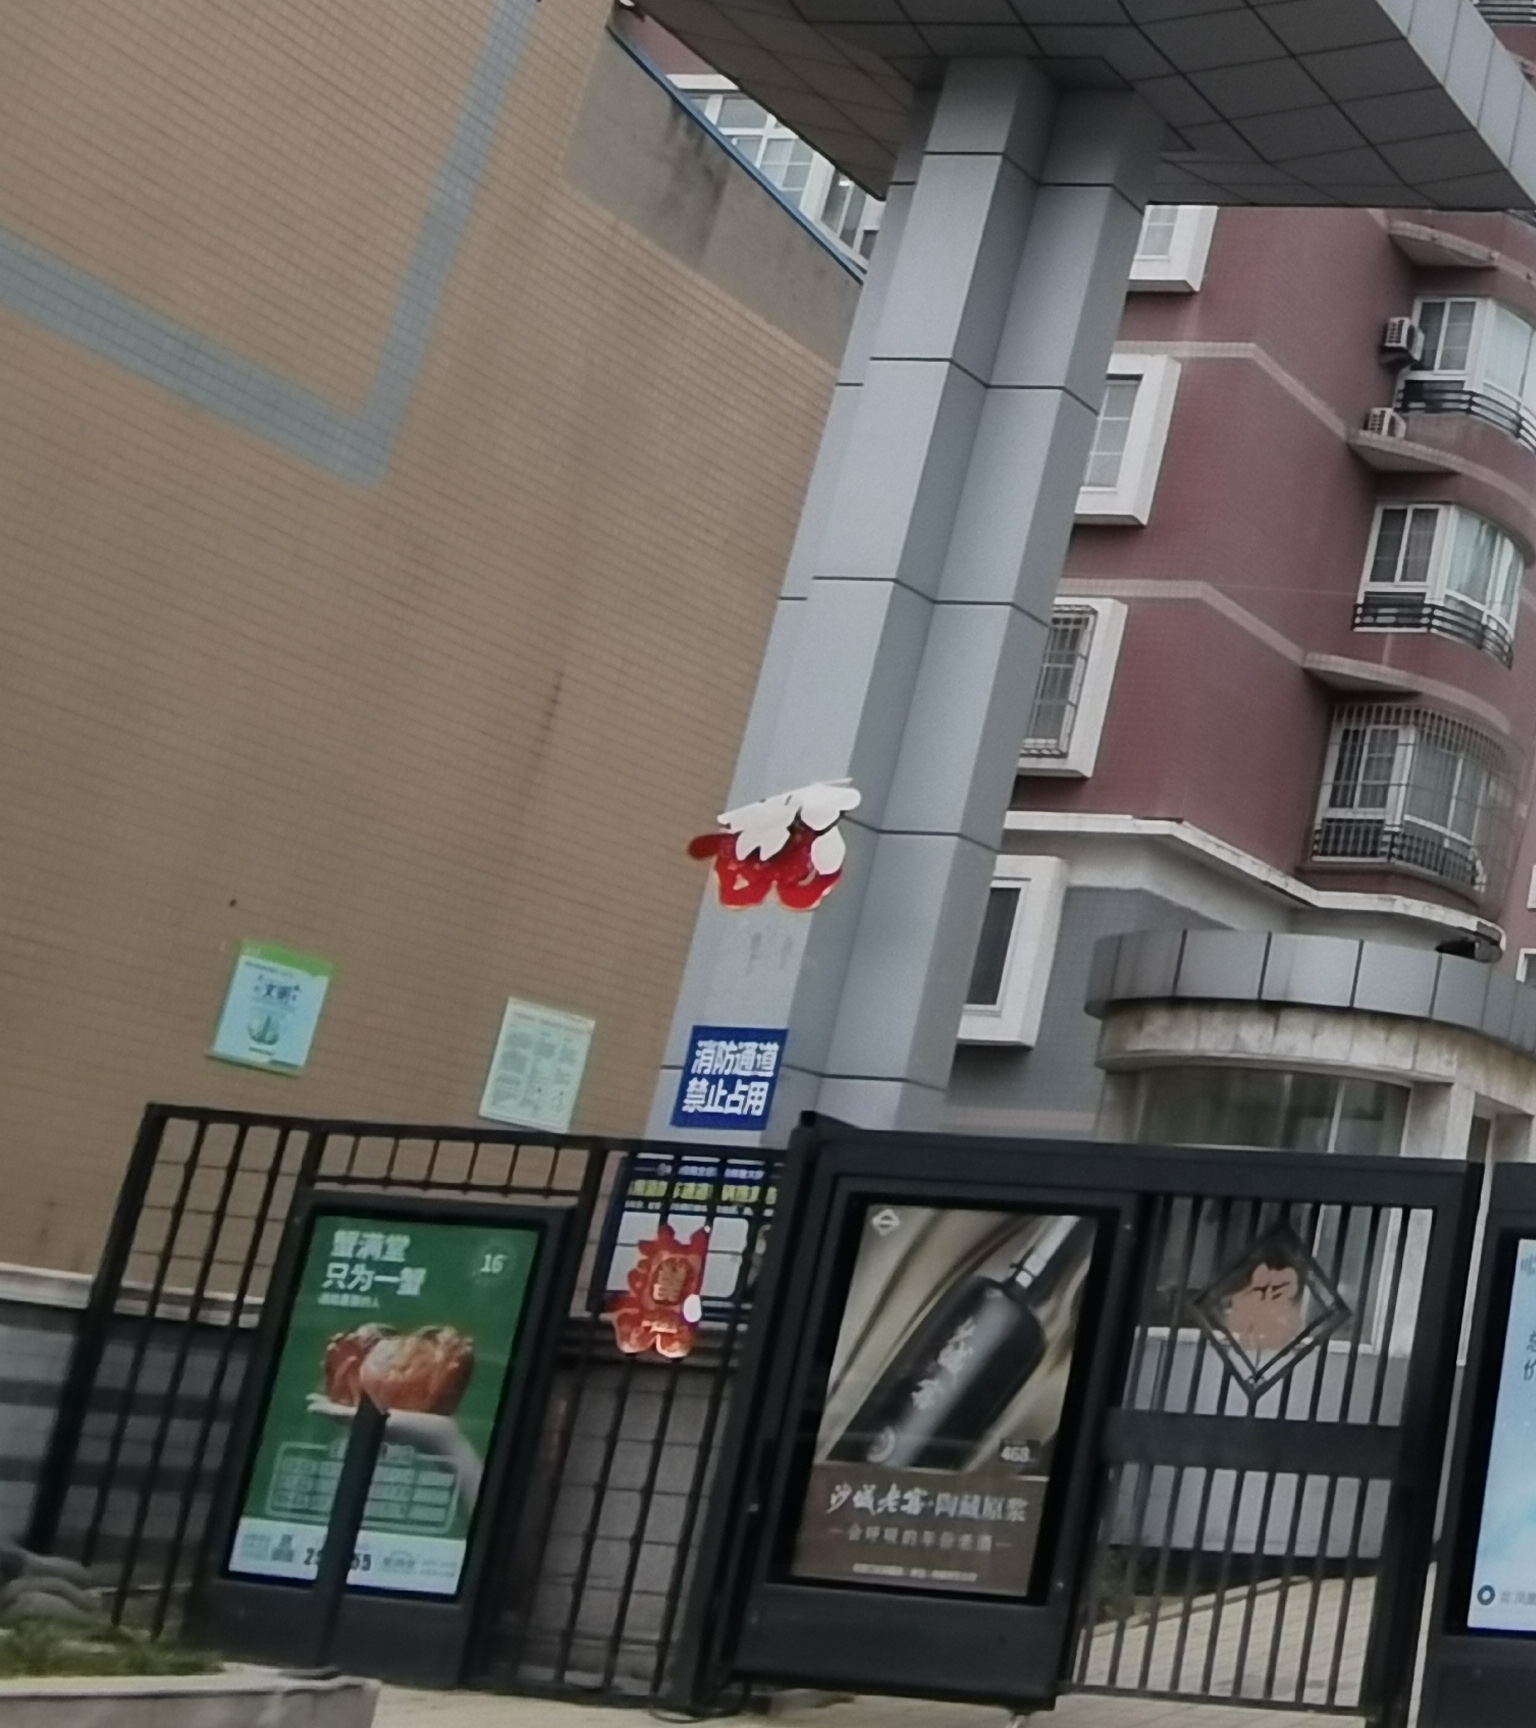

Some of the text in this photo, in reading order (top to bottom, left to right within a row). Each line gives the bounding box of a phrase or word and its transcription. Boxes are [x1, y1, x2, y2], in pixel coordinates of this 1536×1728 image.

[691, 1039, 780, 1078] 消防通道
[681, 1077, 770, 1117] 禁止占用
